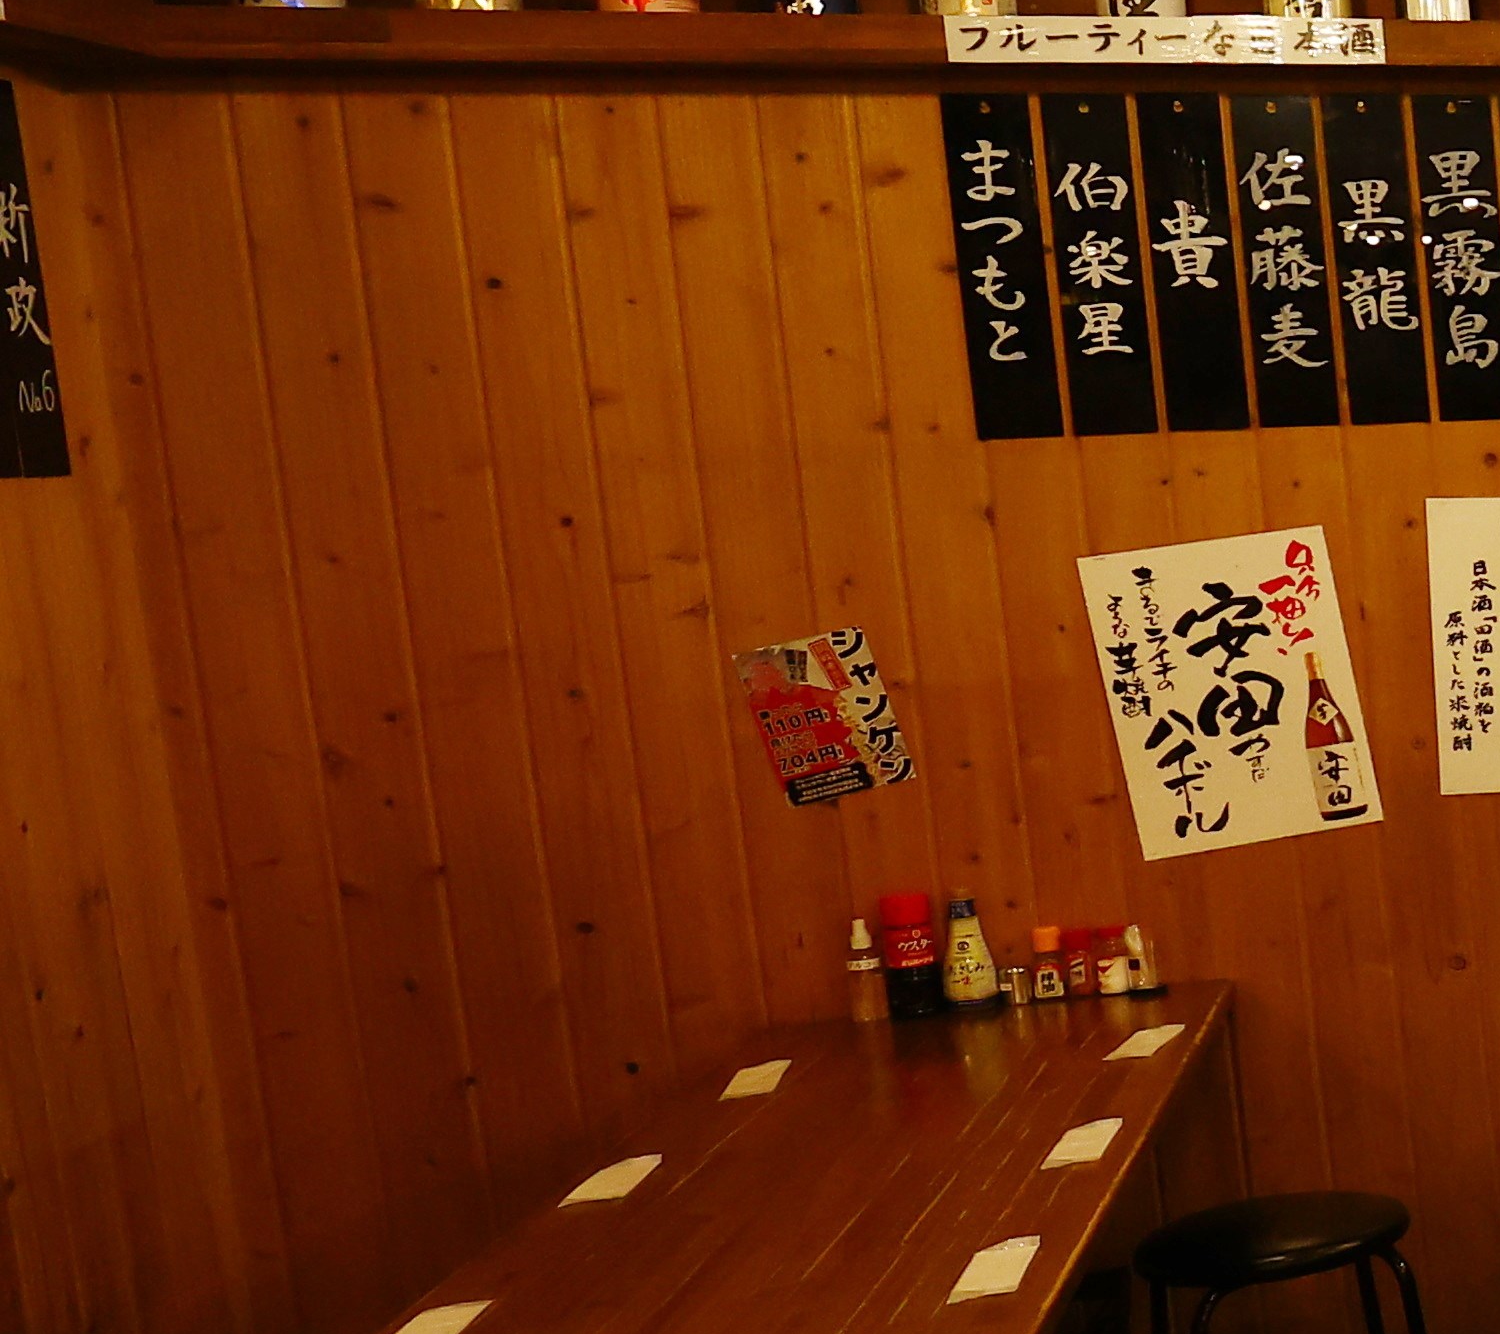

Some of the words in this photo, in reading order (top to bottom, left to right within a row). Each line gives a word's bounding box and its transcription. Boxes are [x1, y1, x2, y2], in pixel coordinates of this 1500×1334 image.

[961, 140, 1027, 361] まつもと
[1054, 161, 1134, 355] 伯楽星
[1151, 200, 1228, 289] 貴
[1239, 147, 1329, 368] 佐藤麦
[1337, 179, 1419, 331] 黒龍
[830, 626, 913, 785] ジャンケン
[1105, 594, 1153, 718] ような芋焼酎
[1131, 566, 1178, 692] まるでライチの
[1172, 582, 1285, 738] 安田
[1444, 610, 1473, 752] 原料とした米焼酎
[1470, 560, 1497, 734] 日本酒「田酒」の酒粕を
[1318, 750, 1353, 807] 安田
